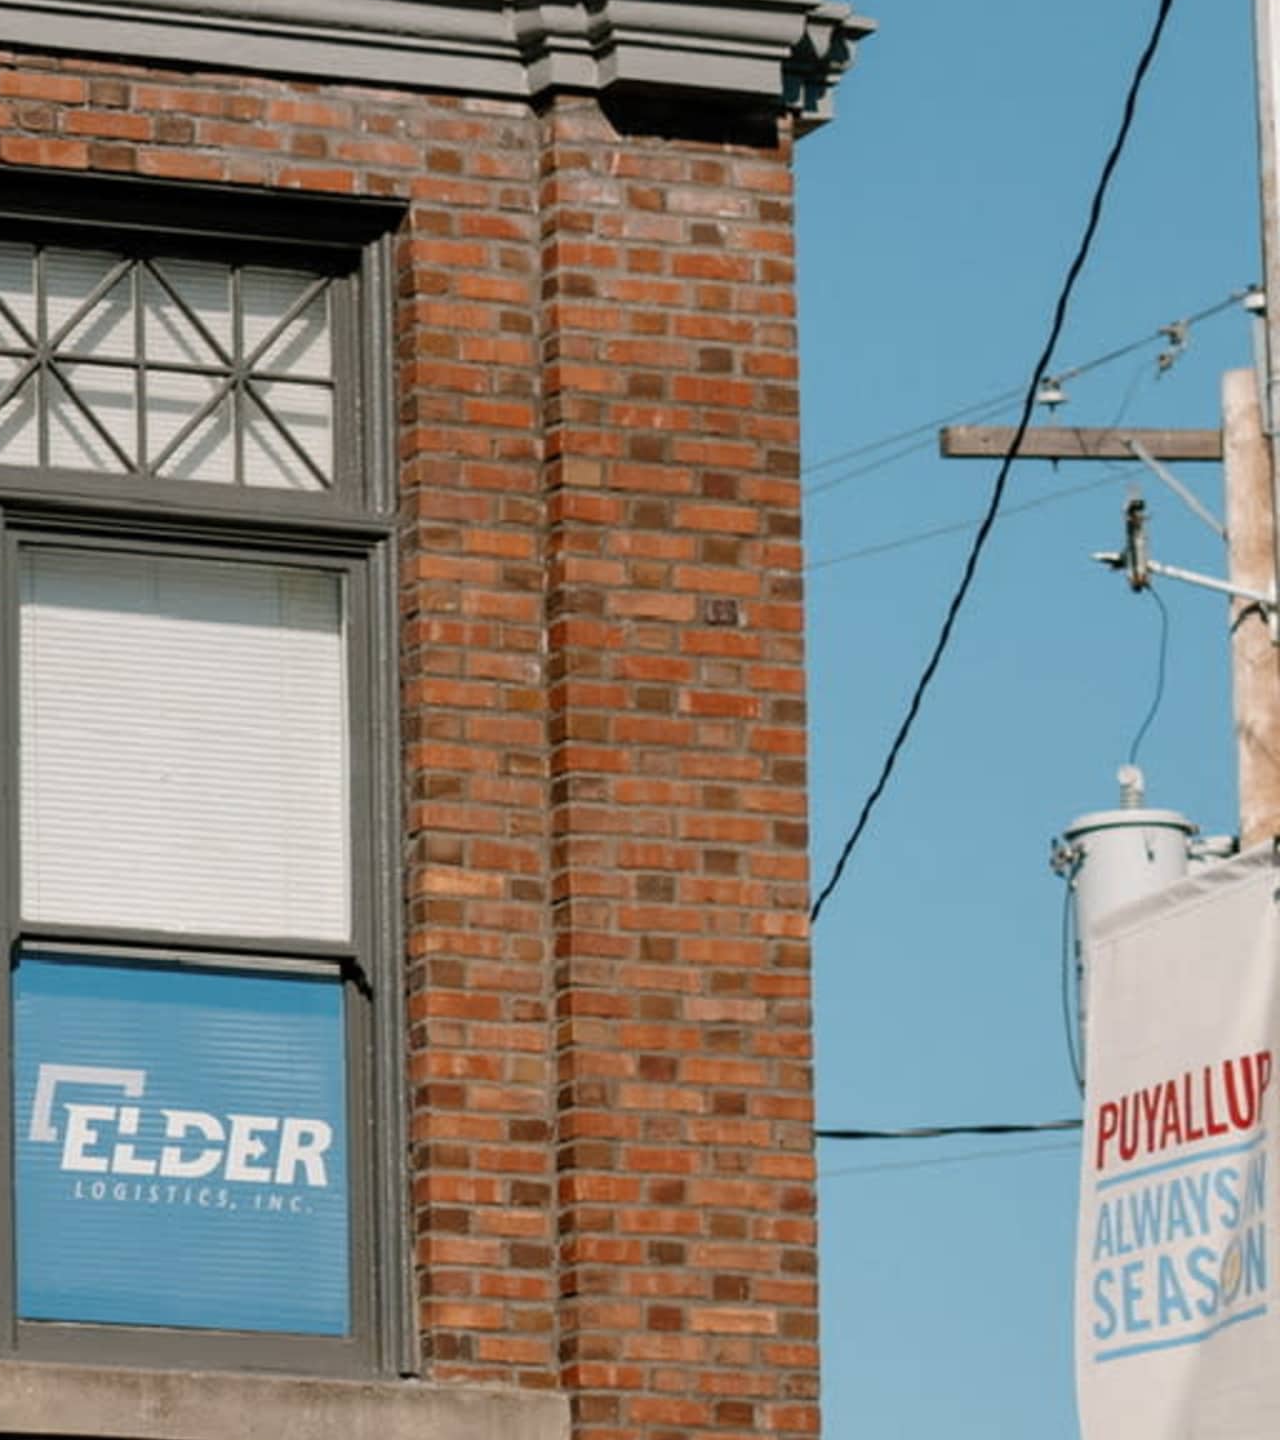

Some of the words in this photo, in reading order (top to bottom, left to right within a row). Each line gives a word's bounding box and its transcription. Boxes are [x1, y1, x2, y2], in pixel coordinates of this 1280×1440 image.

[60, 1102, 333, 1188] ELDER
[1096, 1050, 1272, 1171] PUYALLUP
[1093, 1167, 1240, 1262] ALWAYS
[1093, 1220, 1267, 1340] SEASON
